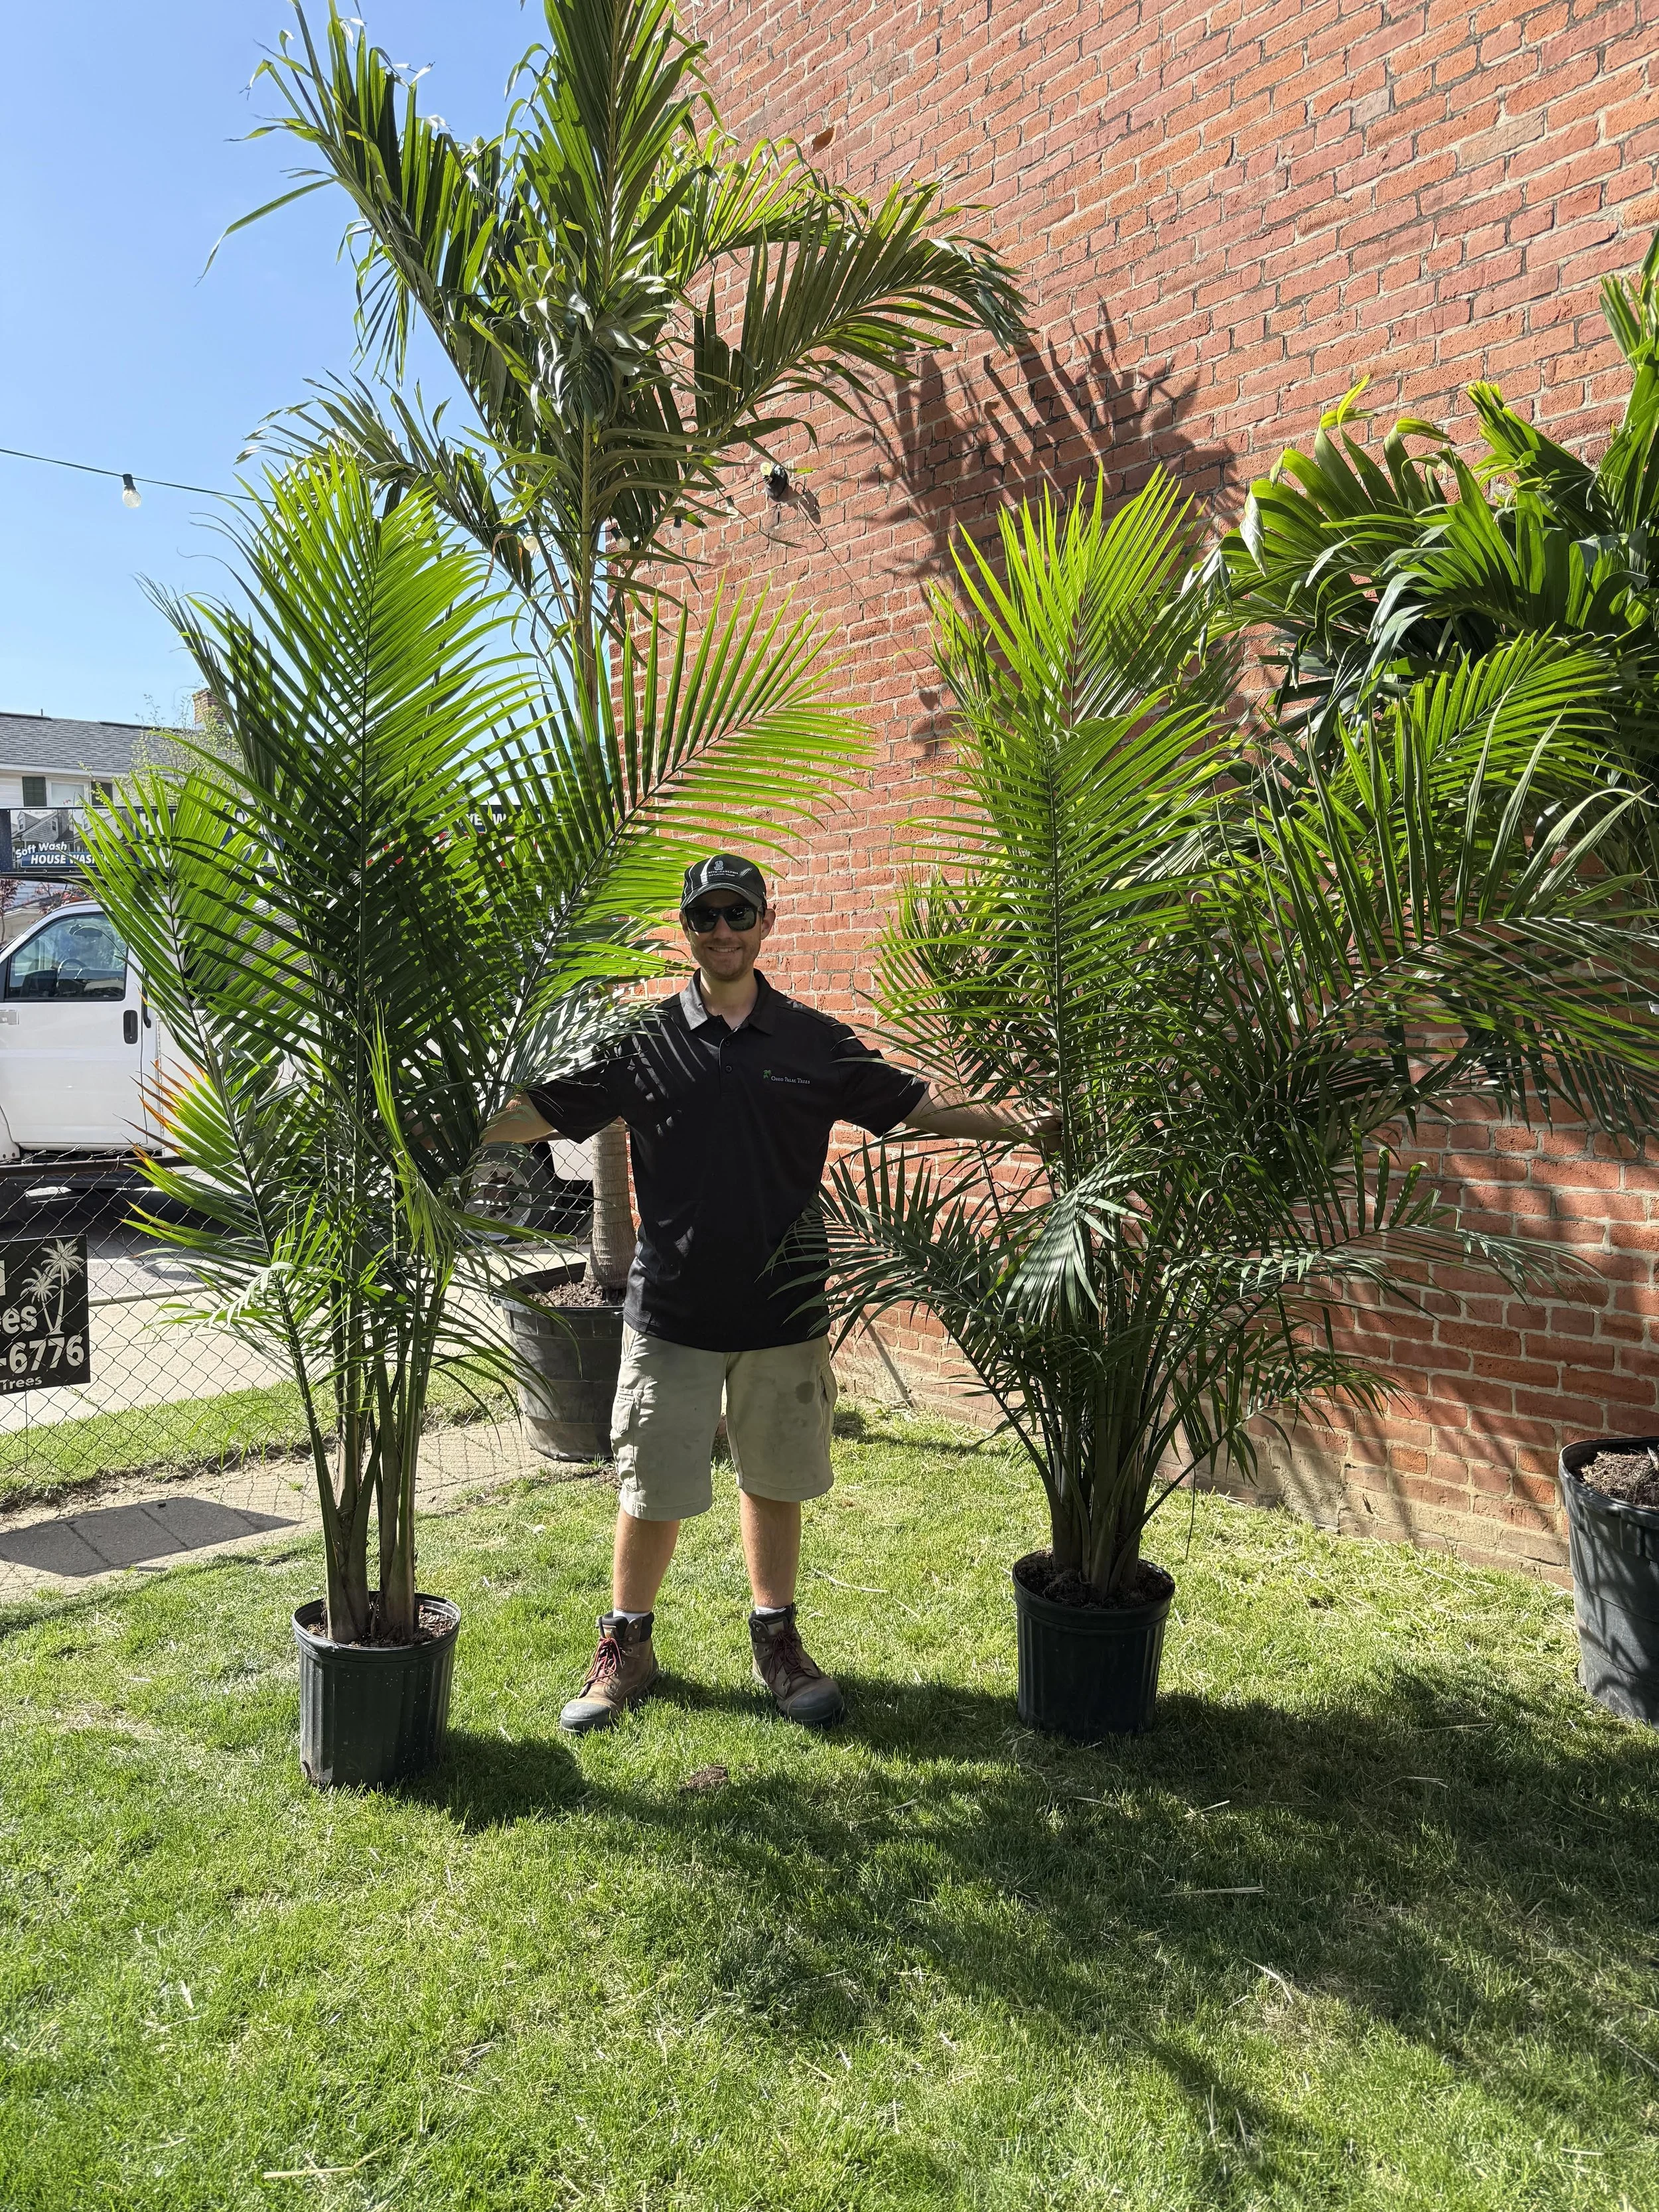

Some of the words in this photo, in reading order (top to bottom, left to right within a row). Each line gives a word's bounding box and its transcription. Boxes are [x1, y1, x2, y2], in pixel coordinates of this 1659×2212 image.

[15, 844, 36, 859] Soft
[38, 841, 68, 852] Wash
[31, 854, 67, 865] HOUSE
[0, 1305, 38, 1335] es
[0, 1376, 42, 1390] Trees
